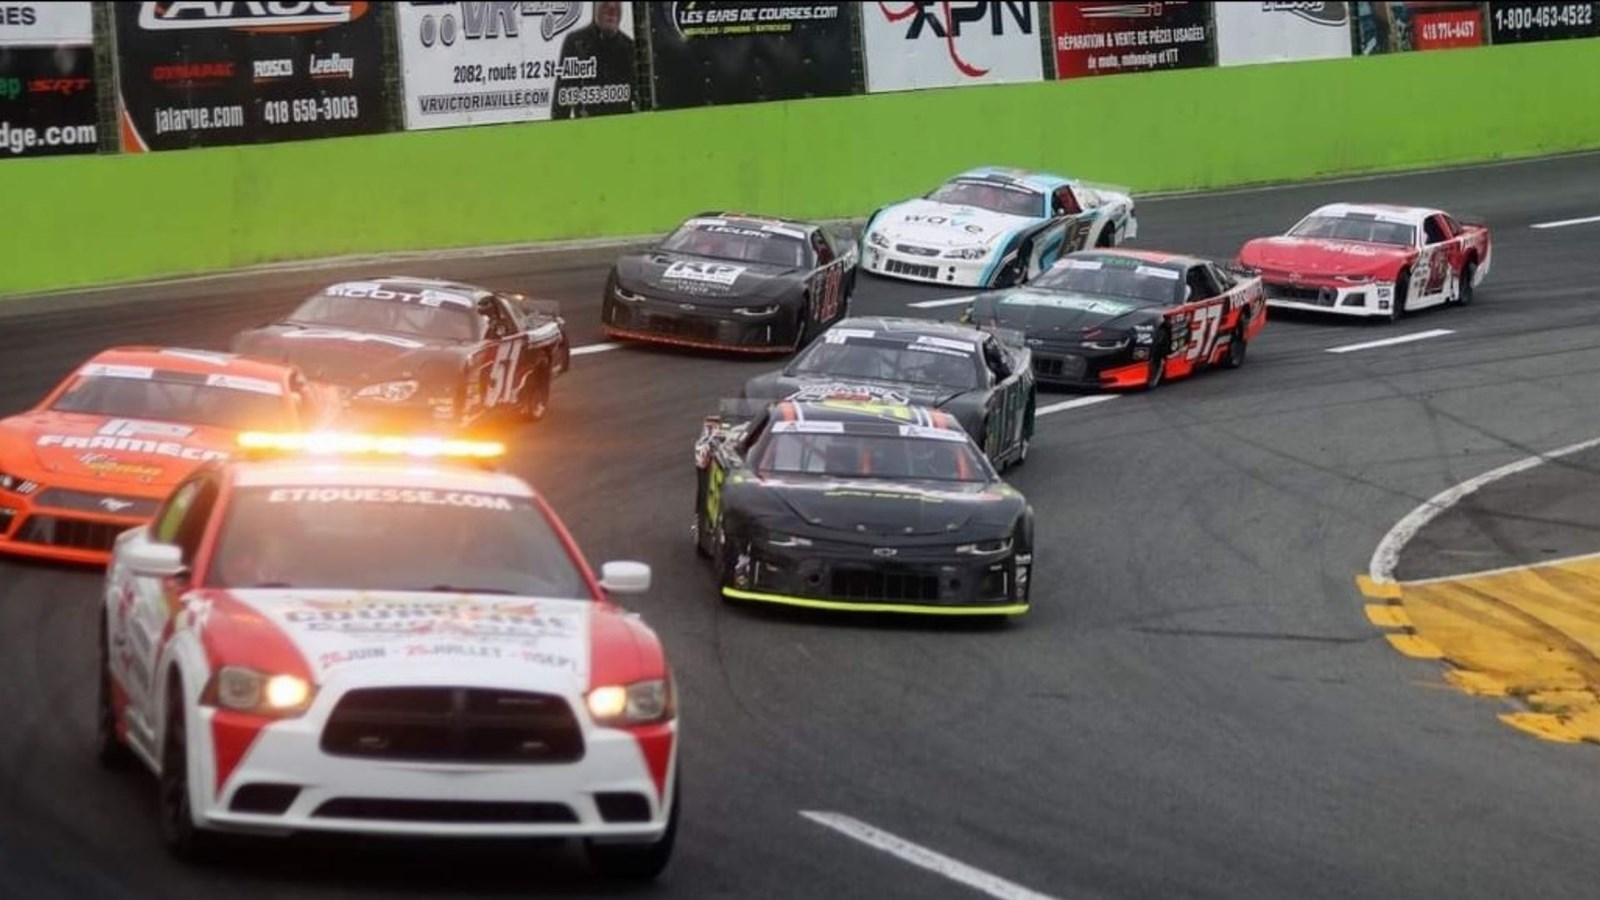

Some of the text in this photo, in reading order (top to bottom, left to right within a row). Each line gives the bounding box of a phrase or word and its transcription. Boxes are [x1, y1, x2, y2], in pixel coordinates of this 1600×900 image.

[680, 6, 838, 24] LES GARS DE COURSES.COM
[905, 2, 1033, 39] XPN
[1495, 5, 1592, 30] 1-800-463-4522
[1114, 31, 1137, 46] VENTE
[1138, 30, 1149, 45] DE
[453, 56, 597, 85] 2082, route 122 St-Albert
[28, 77, 91, 95] SRT
[420, 89, 549, 112] VRVICTORIAVILLE.COM
[155, 96, 358, 134] jalarue.com 418 658-3003
[706, 225, 773, 239] LECLERC
[903, 210, 984, 235] wave
[1186, 303, 1223, 360] 37
[485, 338, 523, 407] 51
[269, 487, 513, 511] ETIQUESSE.COM
